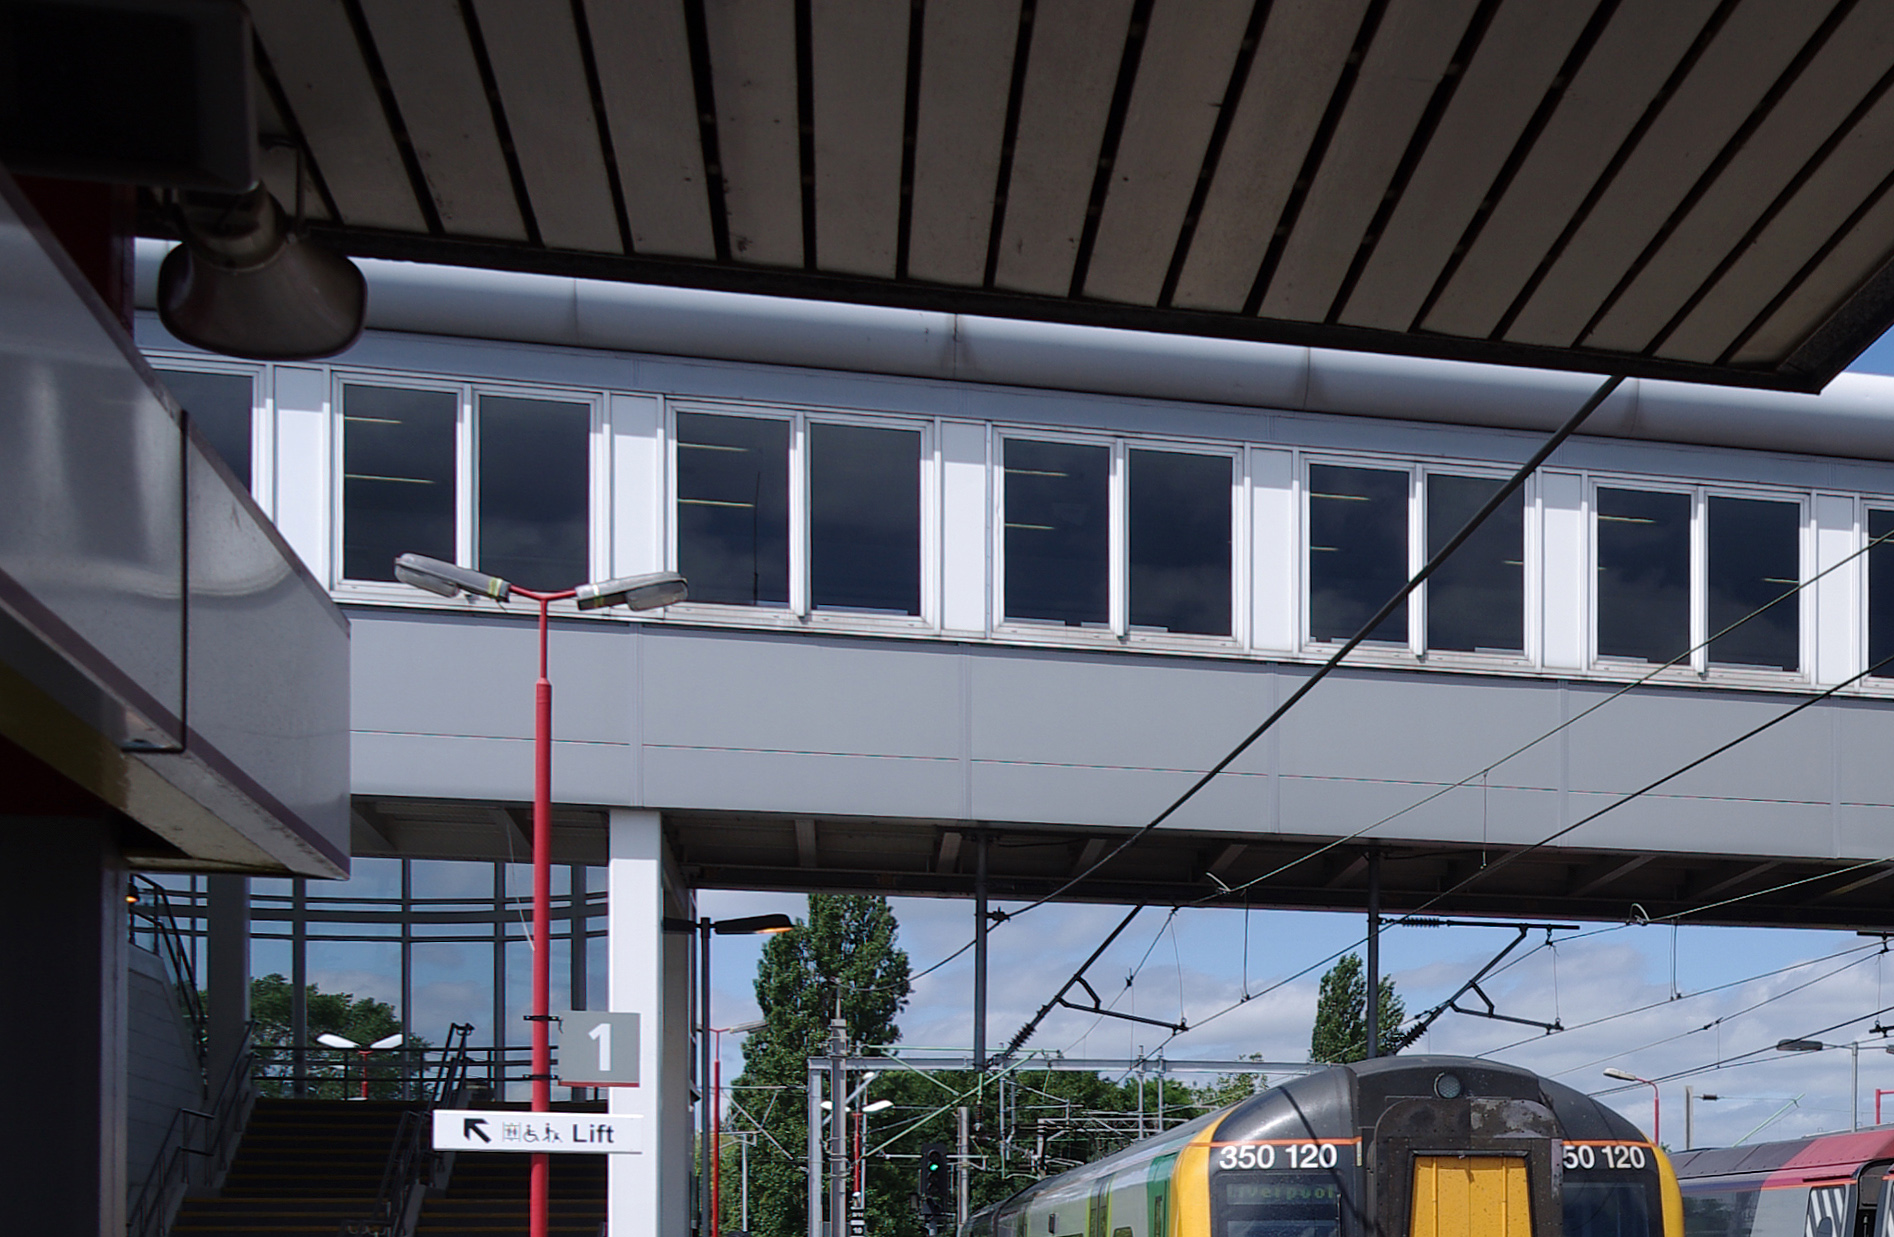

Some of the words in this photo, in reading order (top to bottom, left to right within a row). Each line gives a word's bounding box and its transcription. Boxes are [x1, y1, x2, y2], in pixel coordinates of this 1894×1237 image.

[588, 1022, 612, 1072] 1
[572, 1123, 614, 1144] Lift
[1219, 1144, 1275, 1170] 350
[1285, 1143, 1338, 1169] 120
[1563, 1144, 1596, 1170] 50
[1601, 1145, 1646, 1169] 120
[1228, 1184, 1334, 1201] Liverpool
